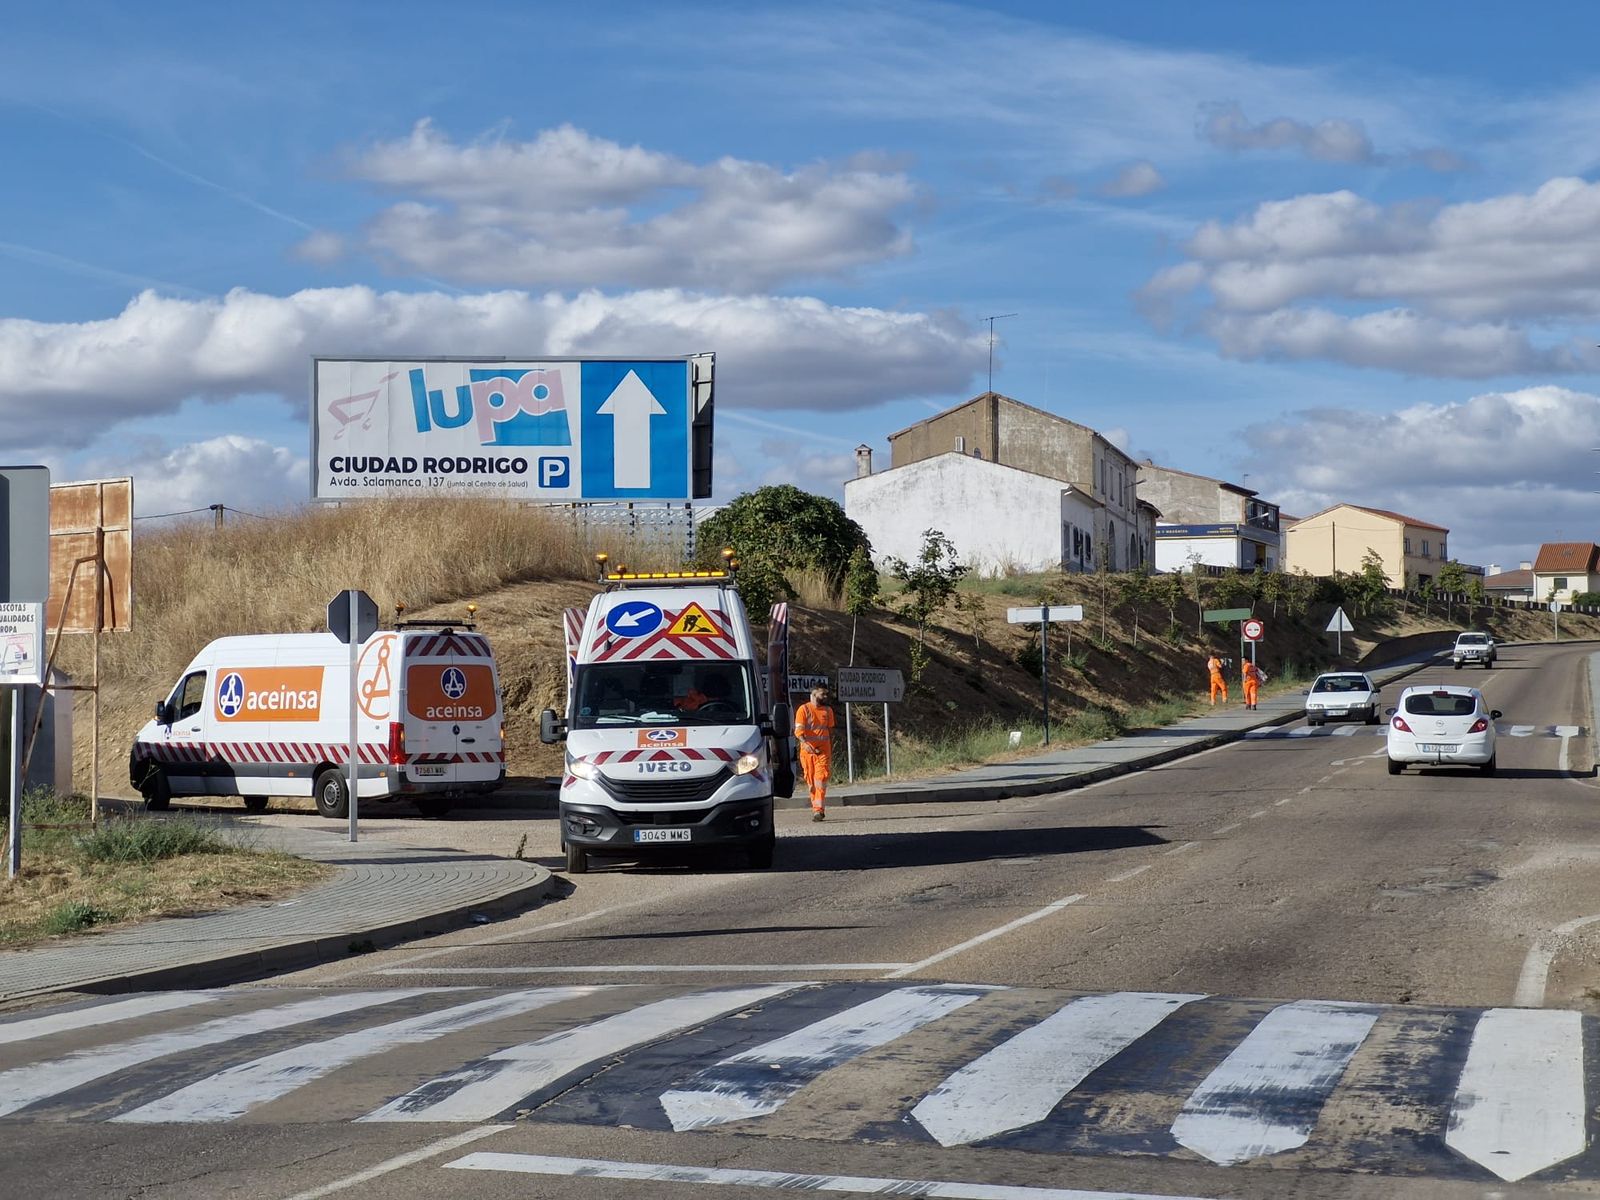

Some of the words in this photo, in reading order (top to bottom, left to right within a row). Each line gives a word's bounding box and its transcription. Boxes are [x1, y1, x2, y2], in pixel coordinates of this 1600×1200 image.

[409, 368, 566, 442] lupa
[329, 456, 418, 474] CIUDAD
[423, 456, 528, 474] RODRIGO
[543, 459, 565, 486] P
[329, 476, 360, 487] Avda.
[363, 476, 425, 488] Salamanca,
[428, 476, 445, 487] 137
[508, 480, 528, 488] Salud)
[839, 671, 860, 683] CIUDAD
[861, 671, 886, 684] RODRIGO
[246, 684, 318, 710] aceinsa
[839, 686, 876, 697] SALAMANCA
[426, 702, 483, 718] aceinsa
[638, 761, 692, 773] IVECO
[641, 831, 667, 840] 3049
[670, 830, 689, 840] MMS
